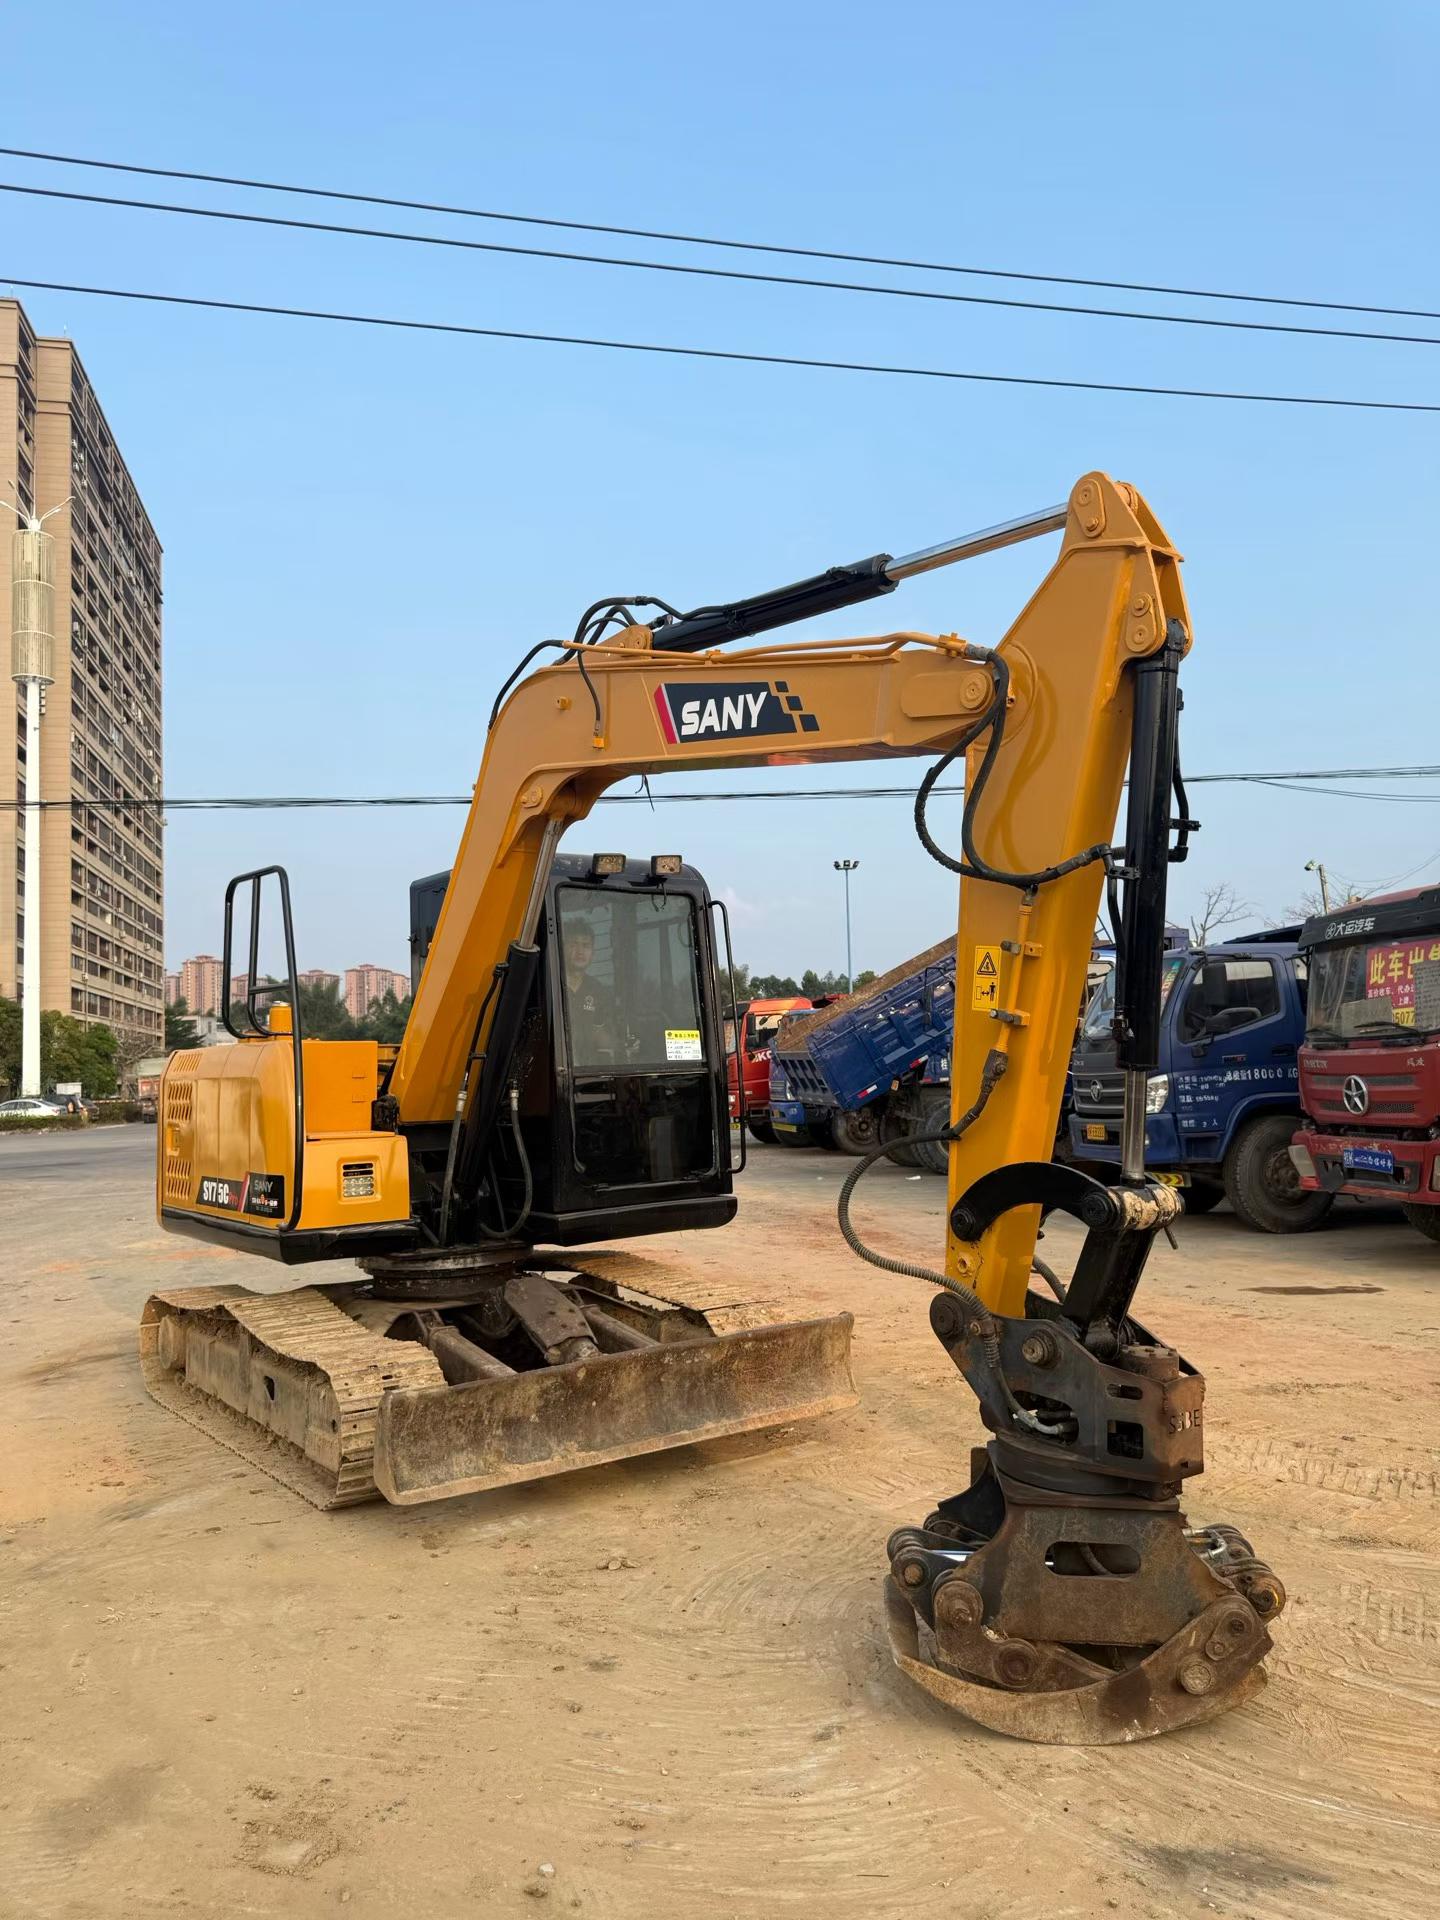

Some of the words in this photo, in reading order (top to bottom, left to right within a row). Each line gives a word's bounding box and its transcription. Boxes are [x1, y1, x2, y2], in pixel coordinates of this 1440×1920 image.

[681, 691, 768, 736] SANY
[1334, 917, 1376, 937] 大运汽车
[203, 1180, 229, 1205] SY75C
[253, 1179, 274, 1193] SANY
